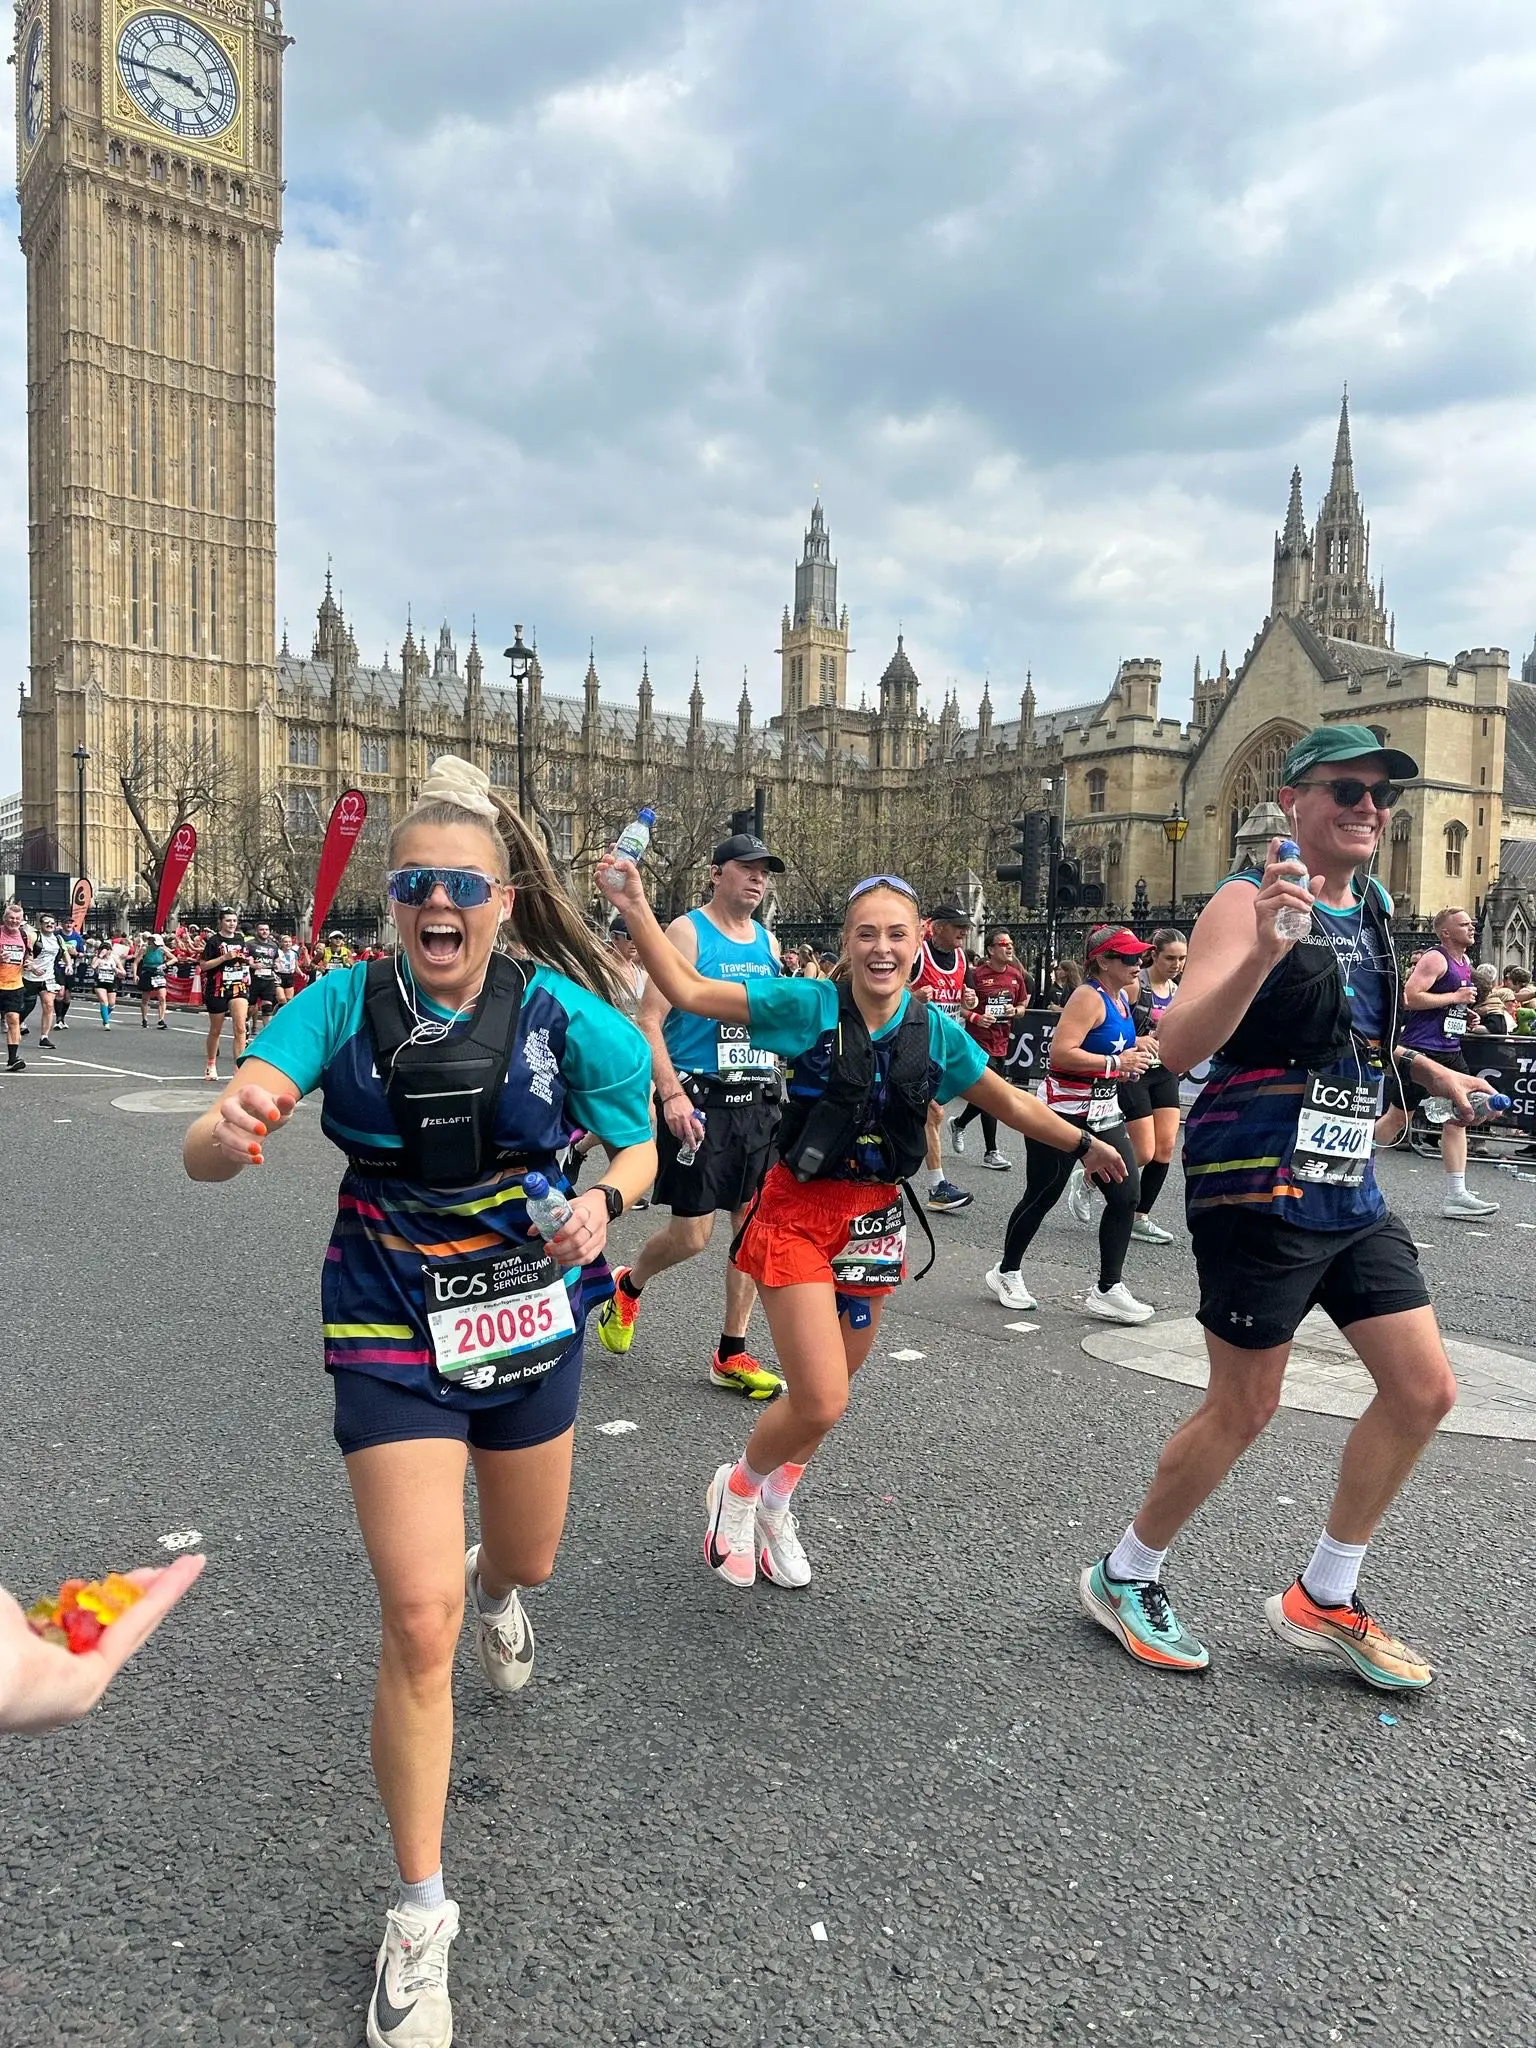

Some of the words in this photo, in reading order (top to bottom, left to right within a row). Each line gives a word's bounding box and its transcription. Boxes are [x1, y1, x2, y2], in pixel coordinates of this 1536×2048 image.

[720, 1024, 745, 1039] tcs
[725, 1091, 753, 1103] nerd
[1311, 1078, 1351, 1109] tcs
[428, 1116, 472, 1126] ZELAFIT
[854, 1217, 884, 1235] tcs
[492, 1255, 522, 1271] TATA
[434, 1271, 488, 1301] tcs
[493, 1273, 539, 1292] SERVICES
[454, 1298, 553, 1354] 20085
[498, 1370, 522, 1385] new
